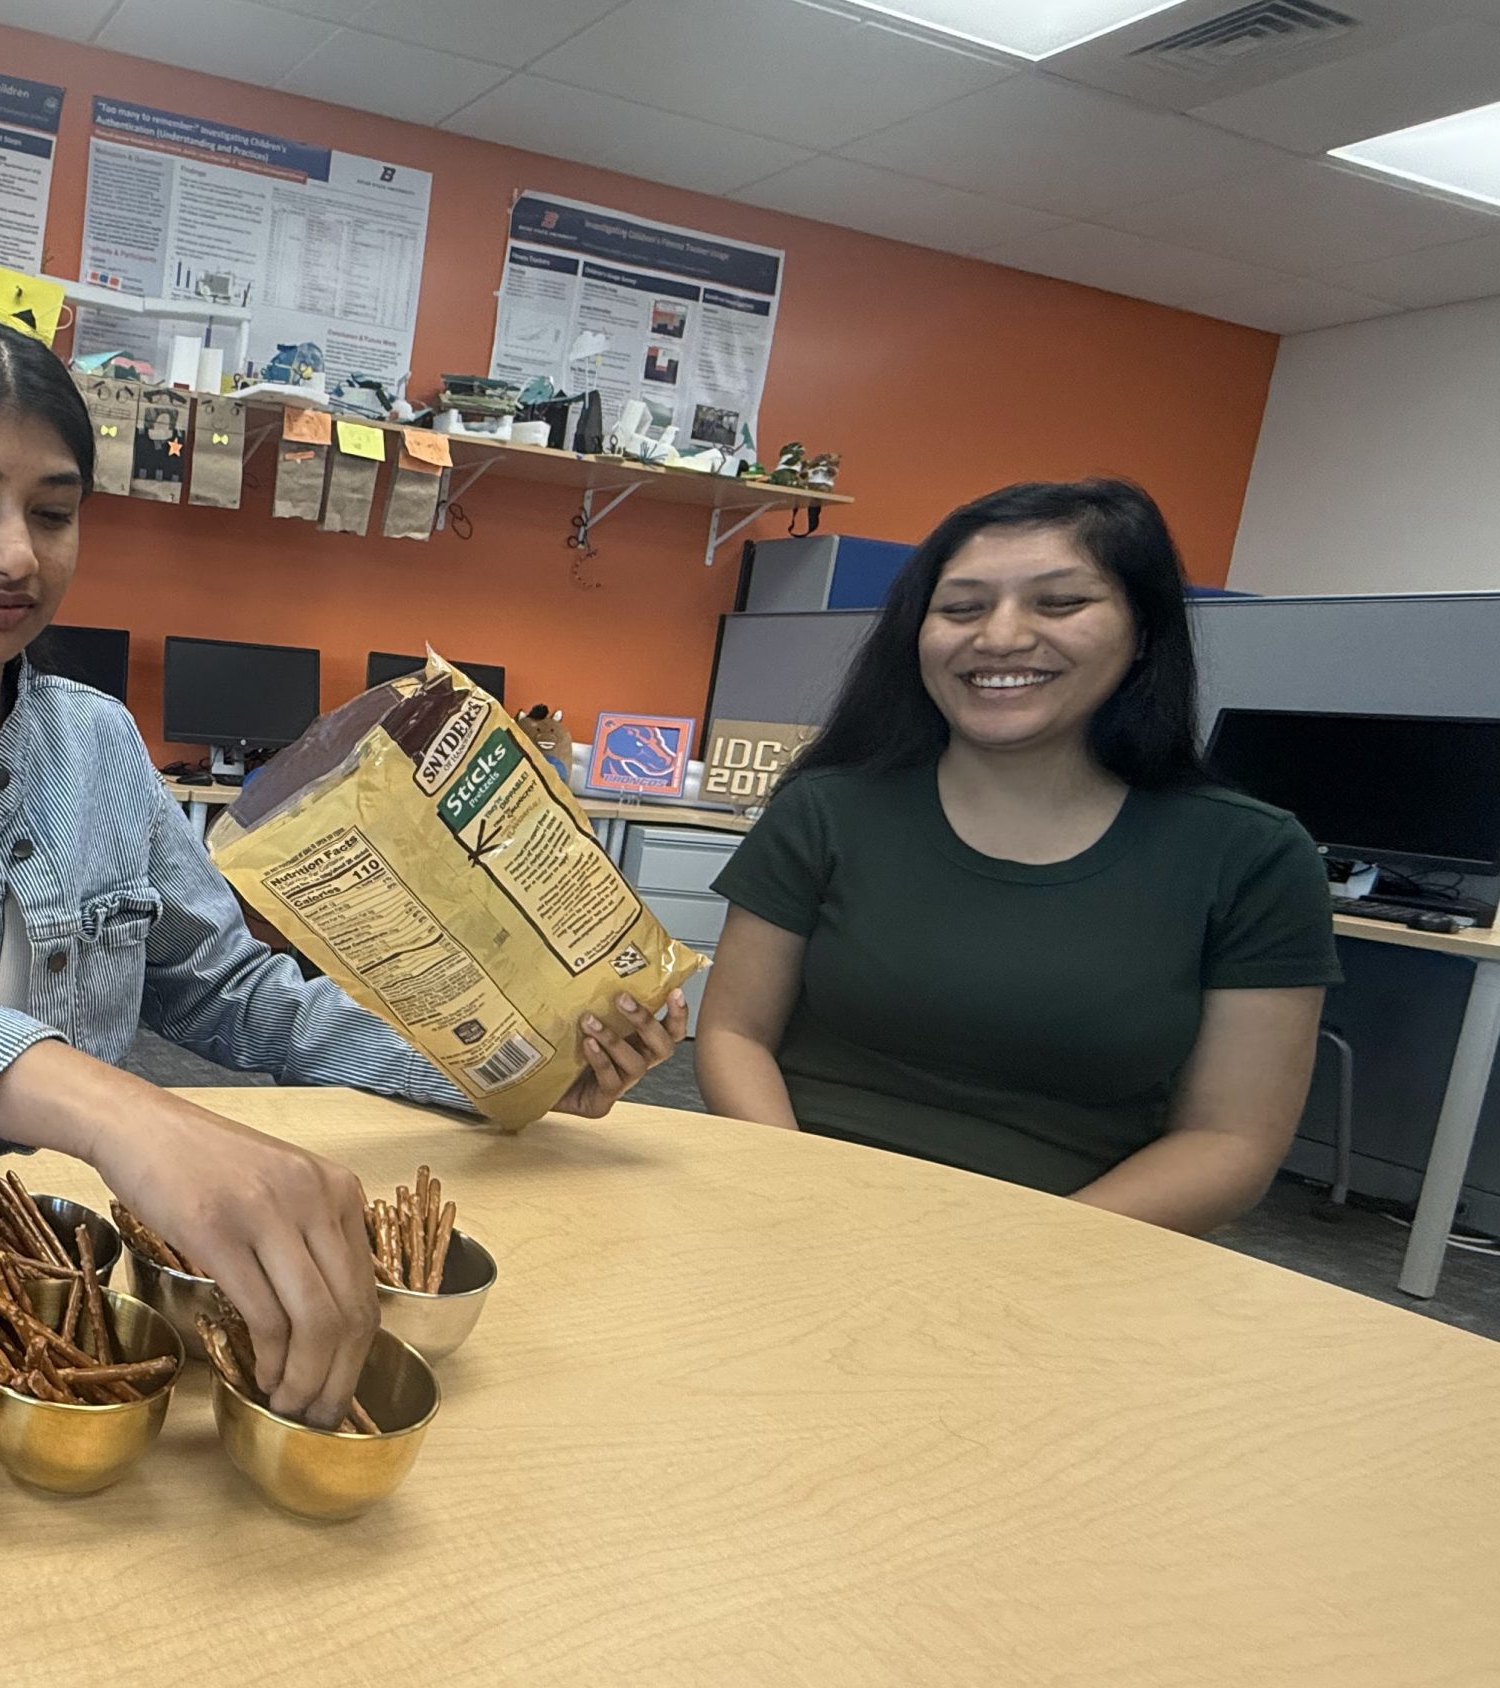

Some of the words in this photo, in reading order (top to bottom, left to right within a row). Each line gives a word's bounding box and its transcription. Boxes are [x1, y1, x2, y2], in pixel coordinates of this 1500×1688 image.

[141, 113, 151, 122] to
[423, 700, 482, 784] SNYDER'S
[711, 737, 783, 772] IDC
[446, 743, 507, 817] Sticks
[468, 771, 501, 808] Pretzels
[269, 855, 323, 888] Nutrition
[324, 836, 359, 861] Facts
[293, 886, 342, 908] Calories
[351, 859, 381, 880] 110
